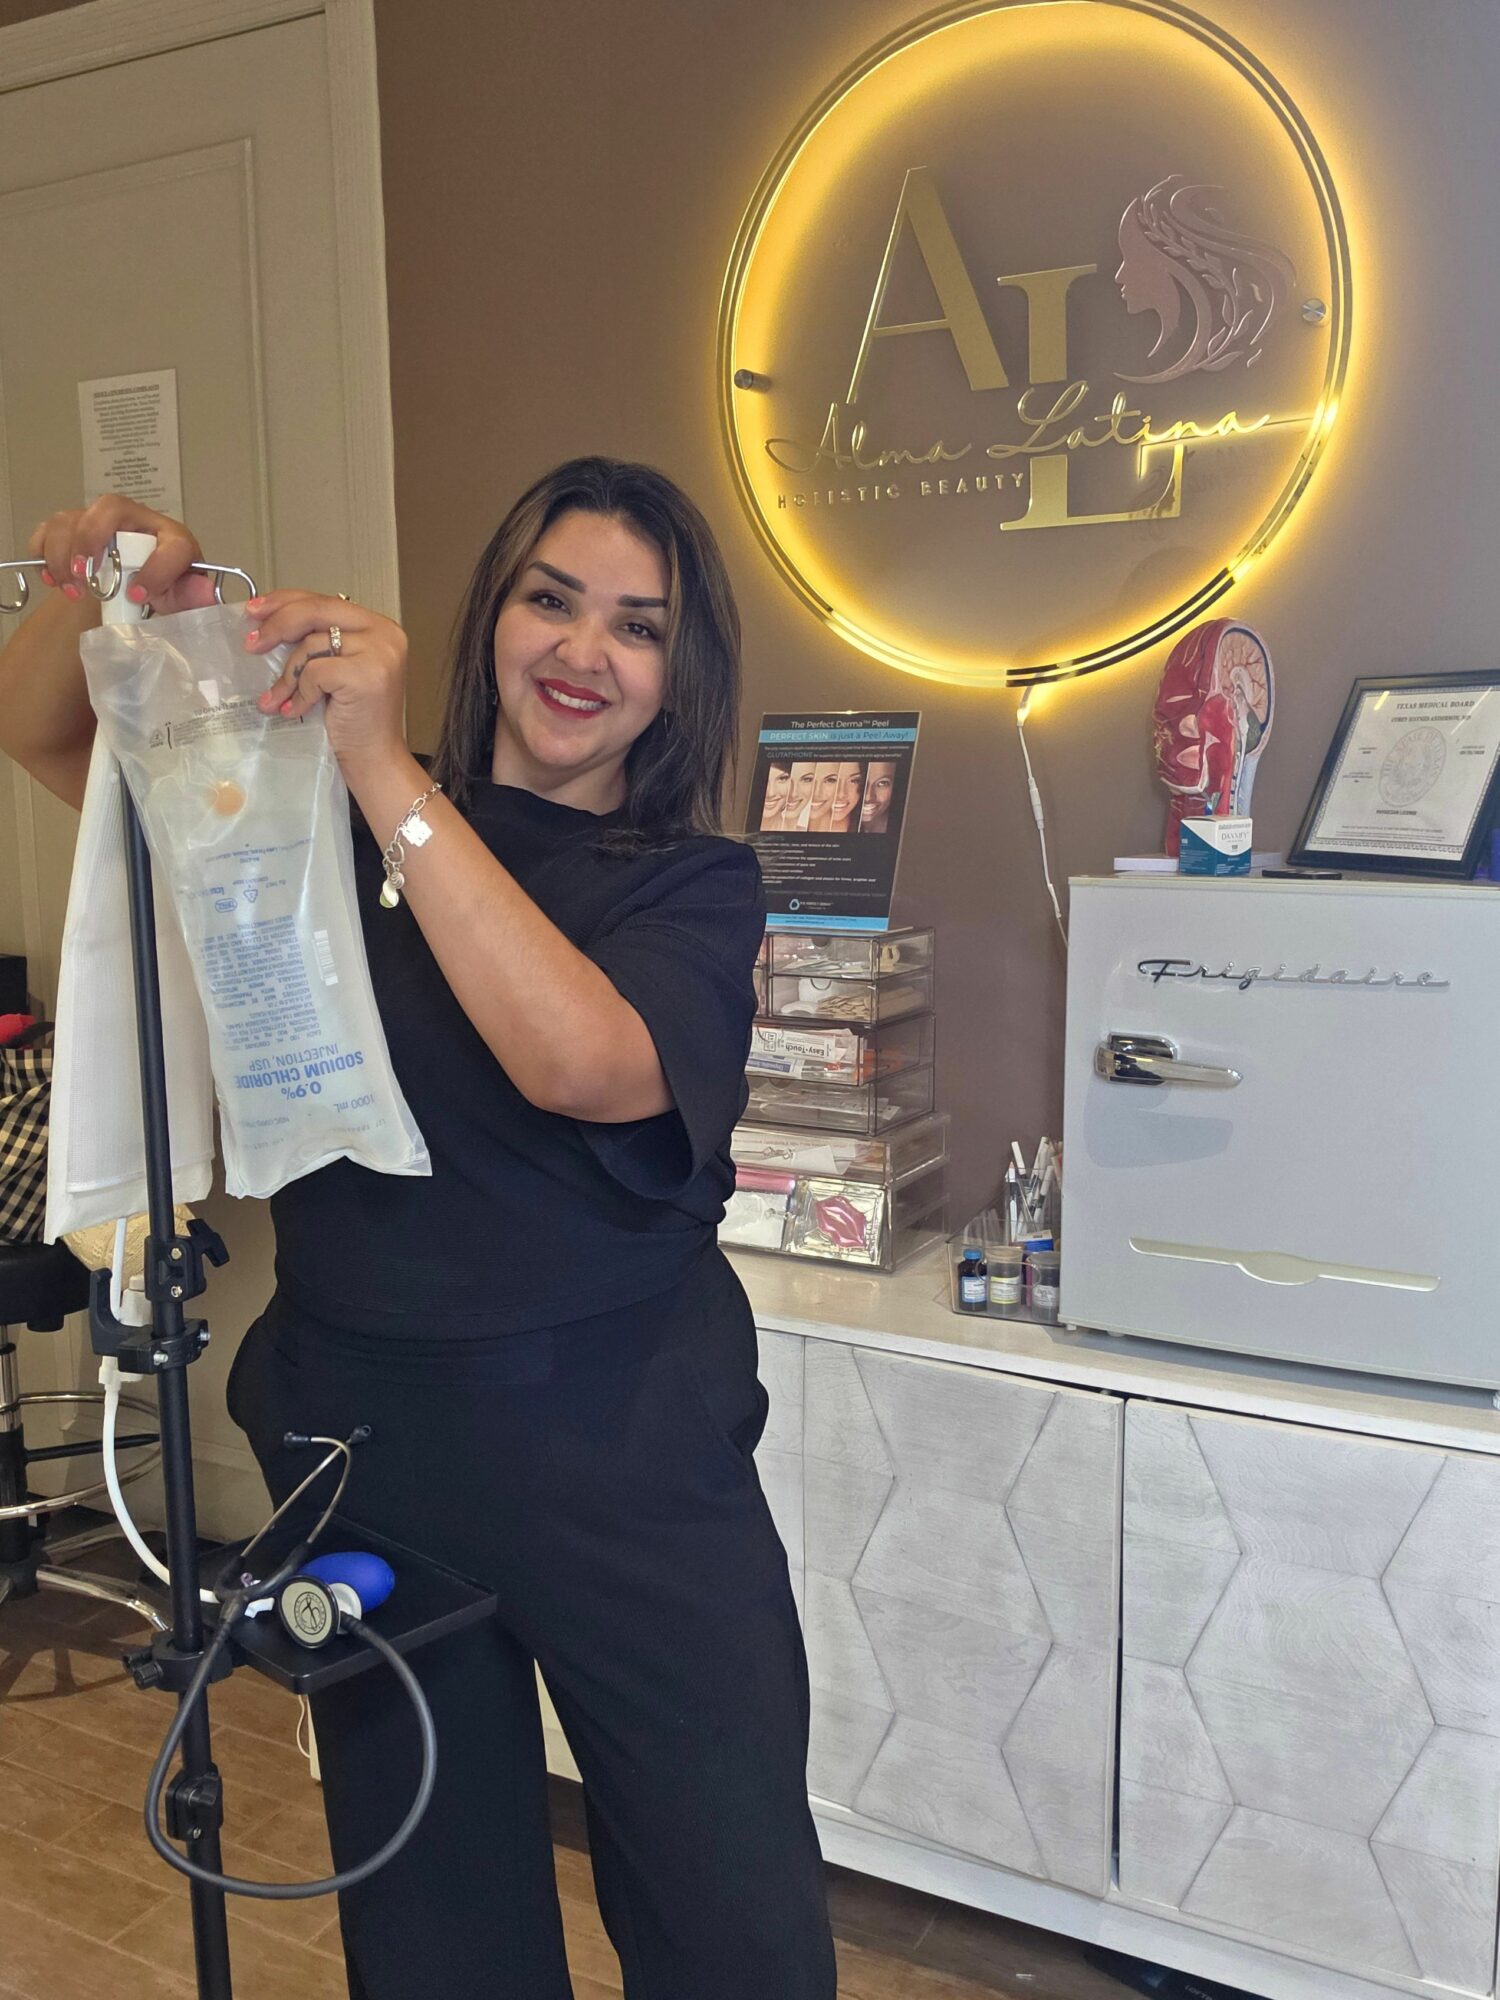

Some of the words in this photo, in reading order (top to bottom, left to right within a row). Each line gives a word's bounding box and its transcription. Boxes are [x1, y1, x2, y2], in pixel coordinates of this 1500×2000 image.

[765, 402, 972, 473] Alma
[986, 381, 1271, 459] Latina
[921, 472, 1024, 496] BEAUTY
[1418, 701, 1448, 709] MEDICAL
[791, 721, 805, 729] The
[806, 720, 834, 729] Perfect
[871, 719, 890, 728] Peel
[769, 732, 808, 740] PERFECT
[808, 732, 829, 740] SKIN
[838, 732, 855, 741] just
[863, 731, 880, 739] Peel
[1137, 958, 1450, 991] Frigidaire
[271, 1043, 339, 1066] INJECTION,
[248, 1058, 270, 1071] USP
[303, 1051, 364, 1078] SODIUM
[233, 1067, 300, 1089] CHLORIDE
[281, 1081, 322, 1100] 0.9%
[333, 1101, 349, 1113] mL
[350, 1094, 376, 1110] 1000
